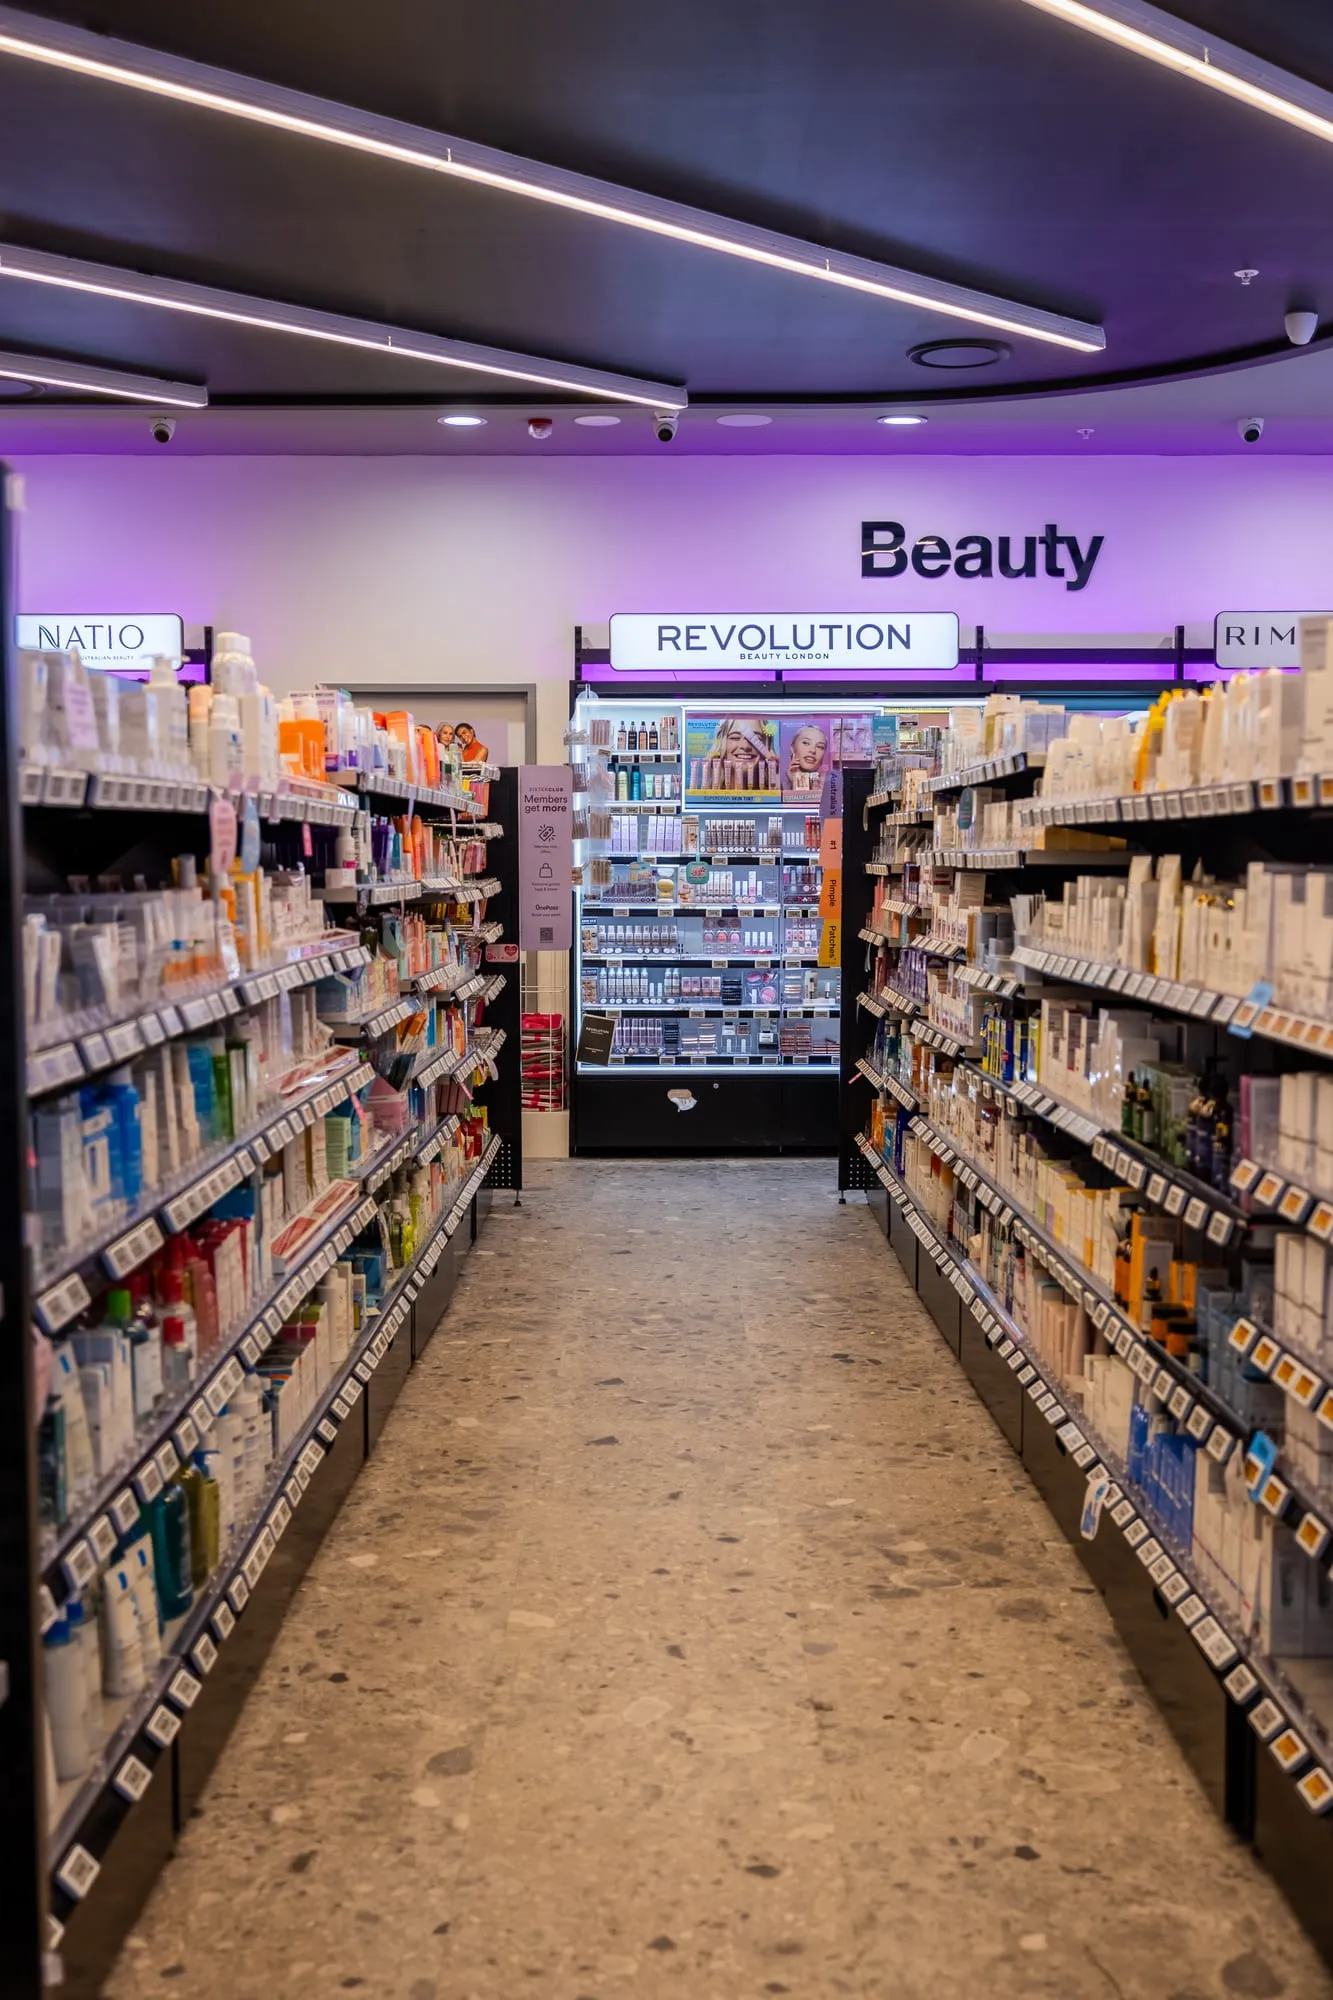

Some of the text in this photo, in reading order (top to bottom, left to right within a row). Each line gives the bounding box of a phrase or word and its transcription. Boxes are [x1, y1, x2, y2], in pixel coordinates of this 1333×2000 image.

[860, 520, 1105, 591] Beauty
[38, 624, 145, 650] NATIO
[657, 624, 912, 651] REVOLUTION
[1225, 625, 1296, 646] RIM
[739, 652, 830, 660] BEAUTY LONDON
[523, 794, 568, 804] Members
[829, 772, 838, 816] Australia's
[524, 804, 567, 814] get more
[829, 839, 837, 850] #1
[828, 879, 838, 907] Pimple
